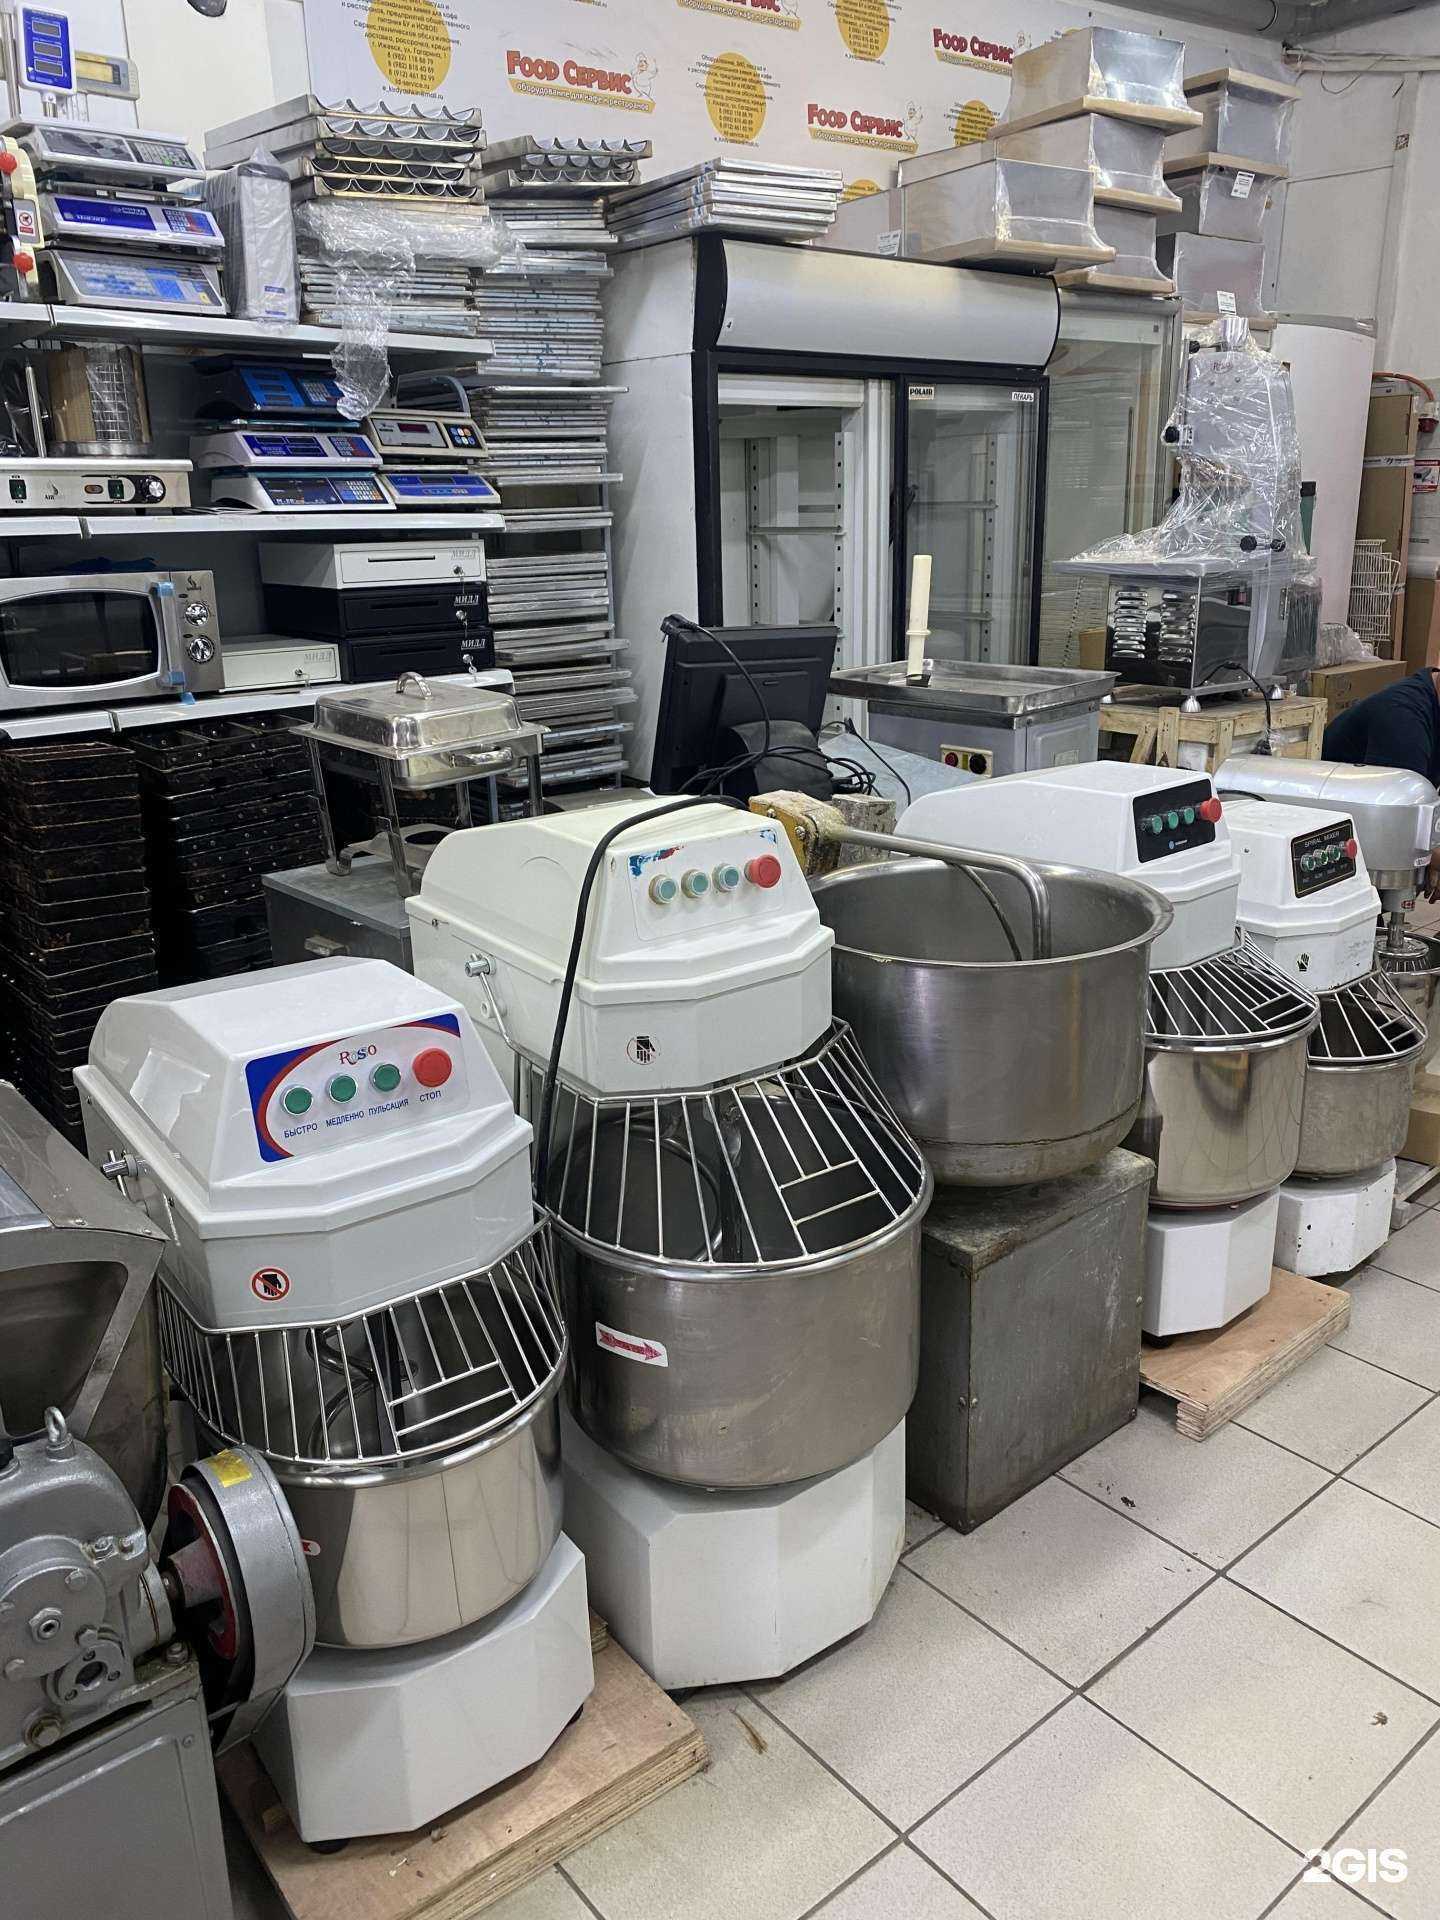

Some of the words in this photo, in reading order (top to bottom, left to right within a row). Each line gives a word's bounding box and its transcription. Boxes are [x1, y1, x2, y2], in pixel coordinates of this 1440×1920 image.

[454, 595, 479, 605] МИДЛ
[461, 638, 486, 649] МИДЛ
[1305, 838, 1322, 848] SPIRAL
[1324, 831, 1340, 840] MIXER
[419, 1090, 442, 1103] СТОП
[284, 1122, 318, 1138] БЫСТРО
[326, 1110, 364, 1128] МЕДЛЕННО
[368, 1098, 409, 1116] ПУЛЬСАЦИЯ
